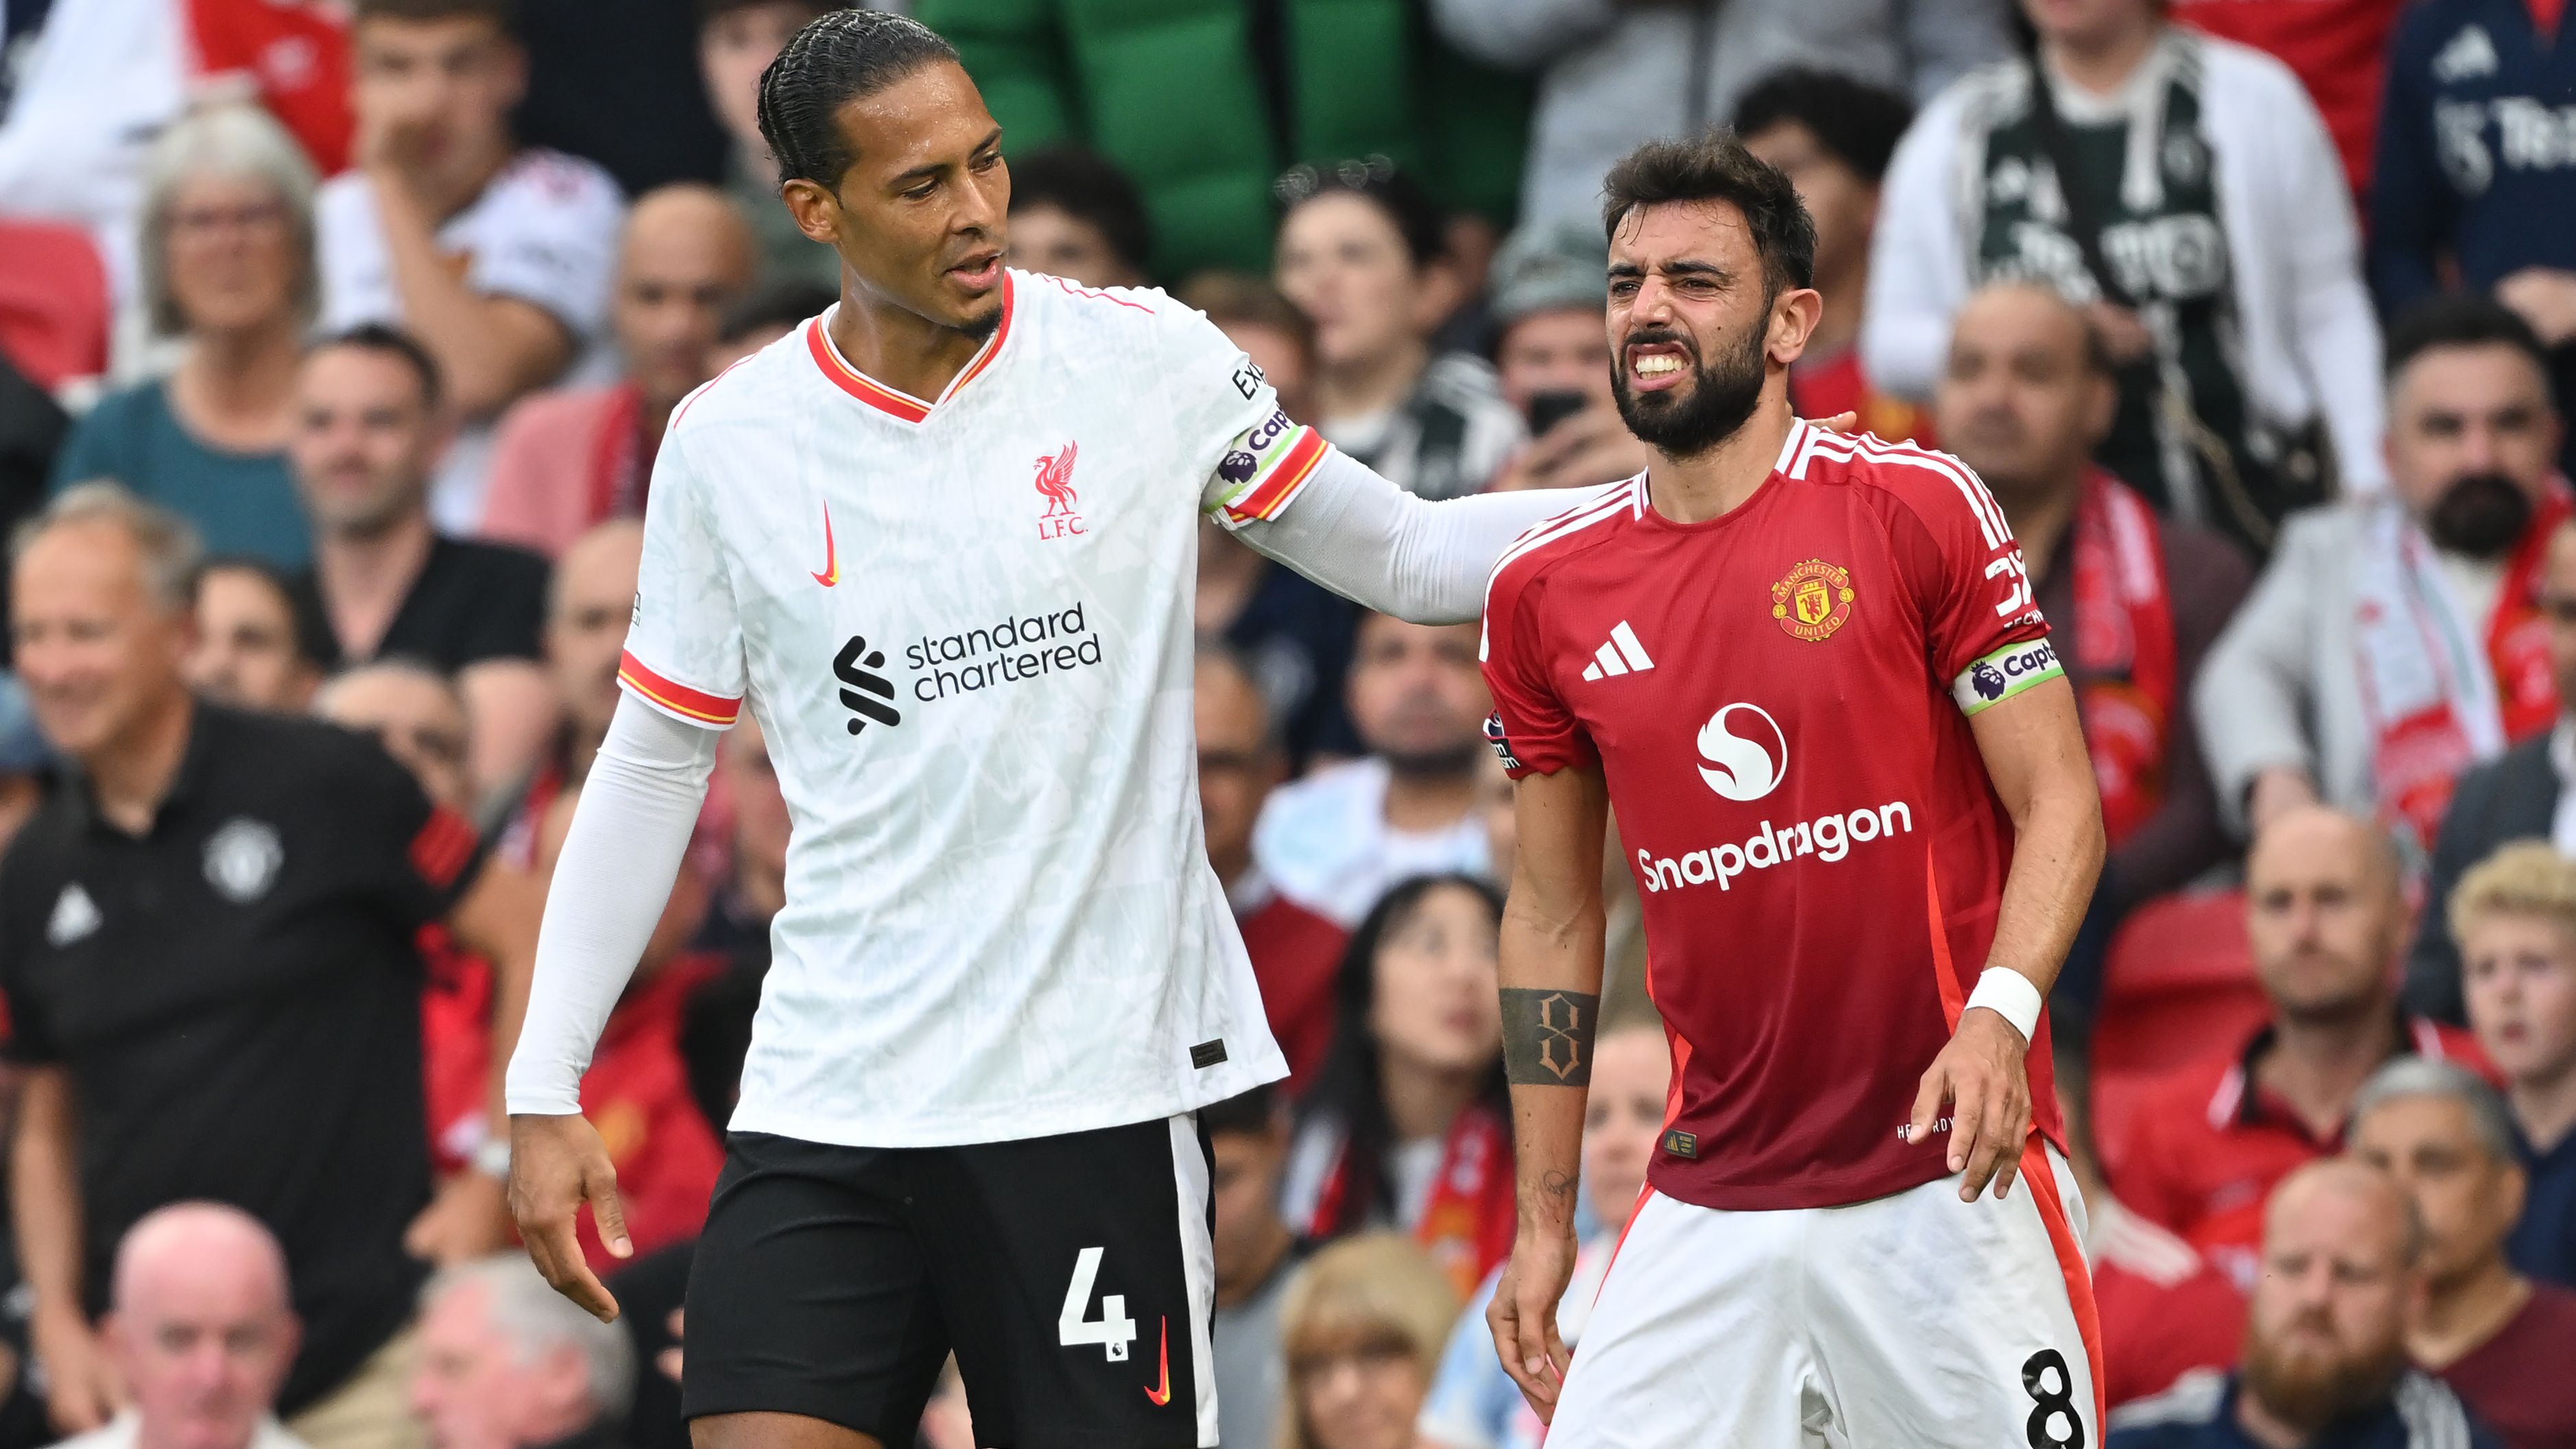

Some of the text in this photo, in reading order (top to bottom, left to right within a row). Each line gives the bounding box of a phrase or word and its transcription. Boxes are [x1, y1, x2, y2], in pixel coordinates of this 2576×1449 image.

[1248, 403, 1291, 451] Cap
[1038, 516, 1089, 540] L.F.C.
[1777, 564, 1843, 598] MANCHESTER
[906, 601, 1085, 670] standard
[1794, 616, 1841, 636] UNITED
[914, 632, 1102, 702] chartered
[2003, 643, 2056, 677] Capt
[1638, 801, 1913, 893] Snapdragon
[1058, 1247, 1136, 1362] 4
[2021, 1348, 2086, 1449] 8
